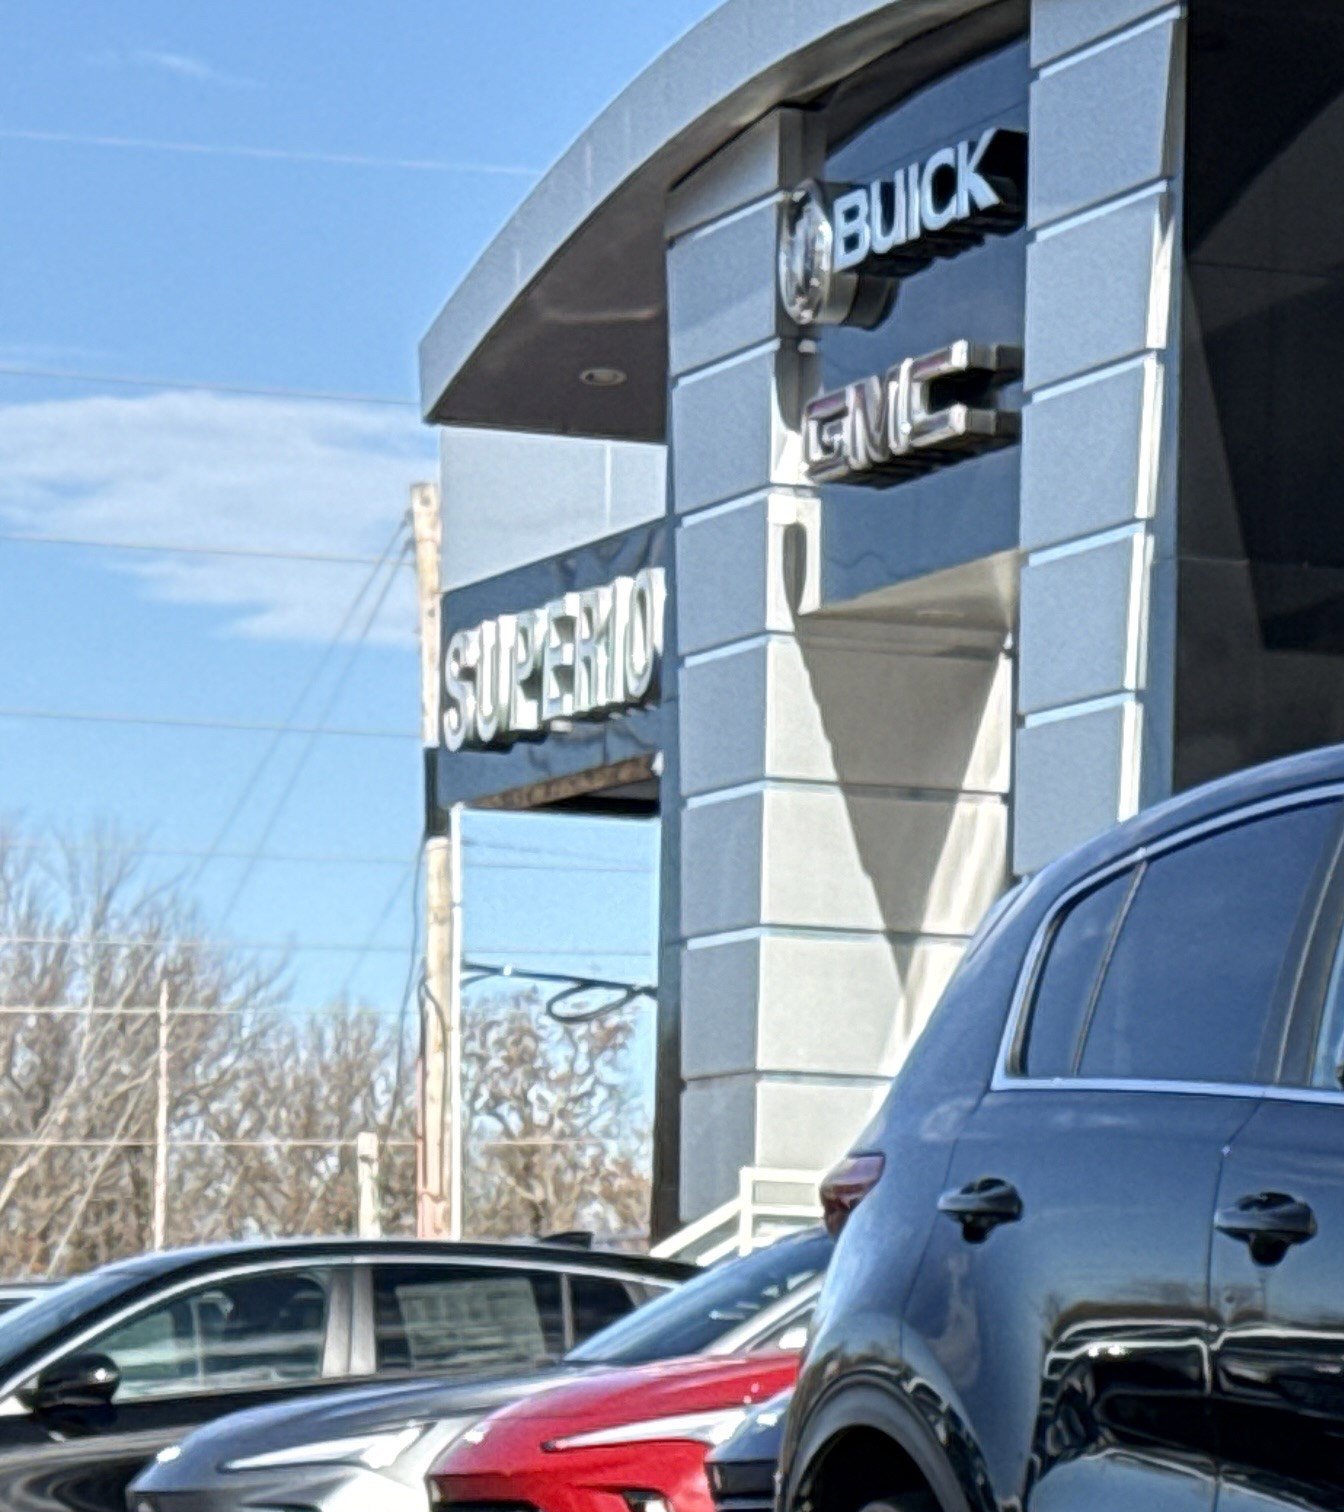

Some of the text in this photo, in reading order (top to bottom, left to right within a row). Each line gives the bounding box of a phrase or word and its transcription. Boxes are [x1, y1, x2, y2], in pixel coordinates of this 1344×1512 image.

[833, 128, 1002, 272] BUICK
[802, 339, 968, 481] GMC
[443, 567, 667, 752] SUPERIO
